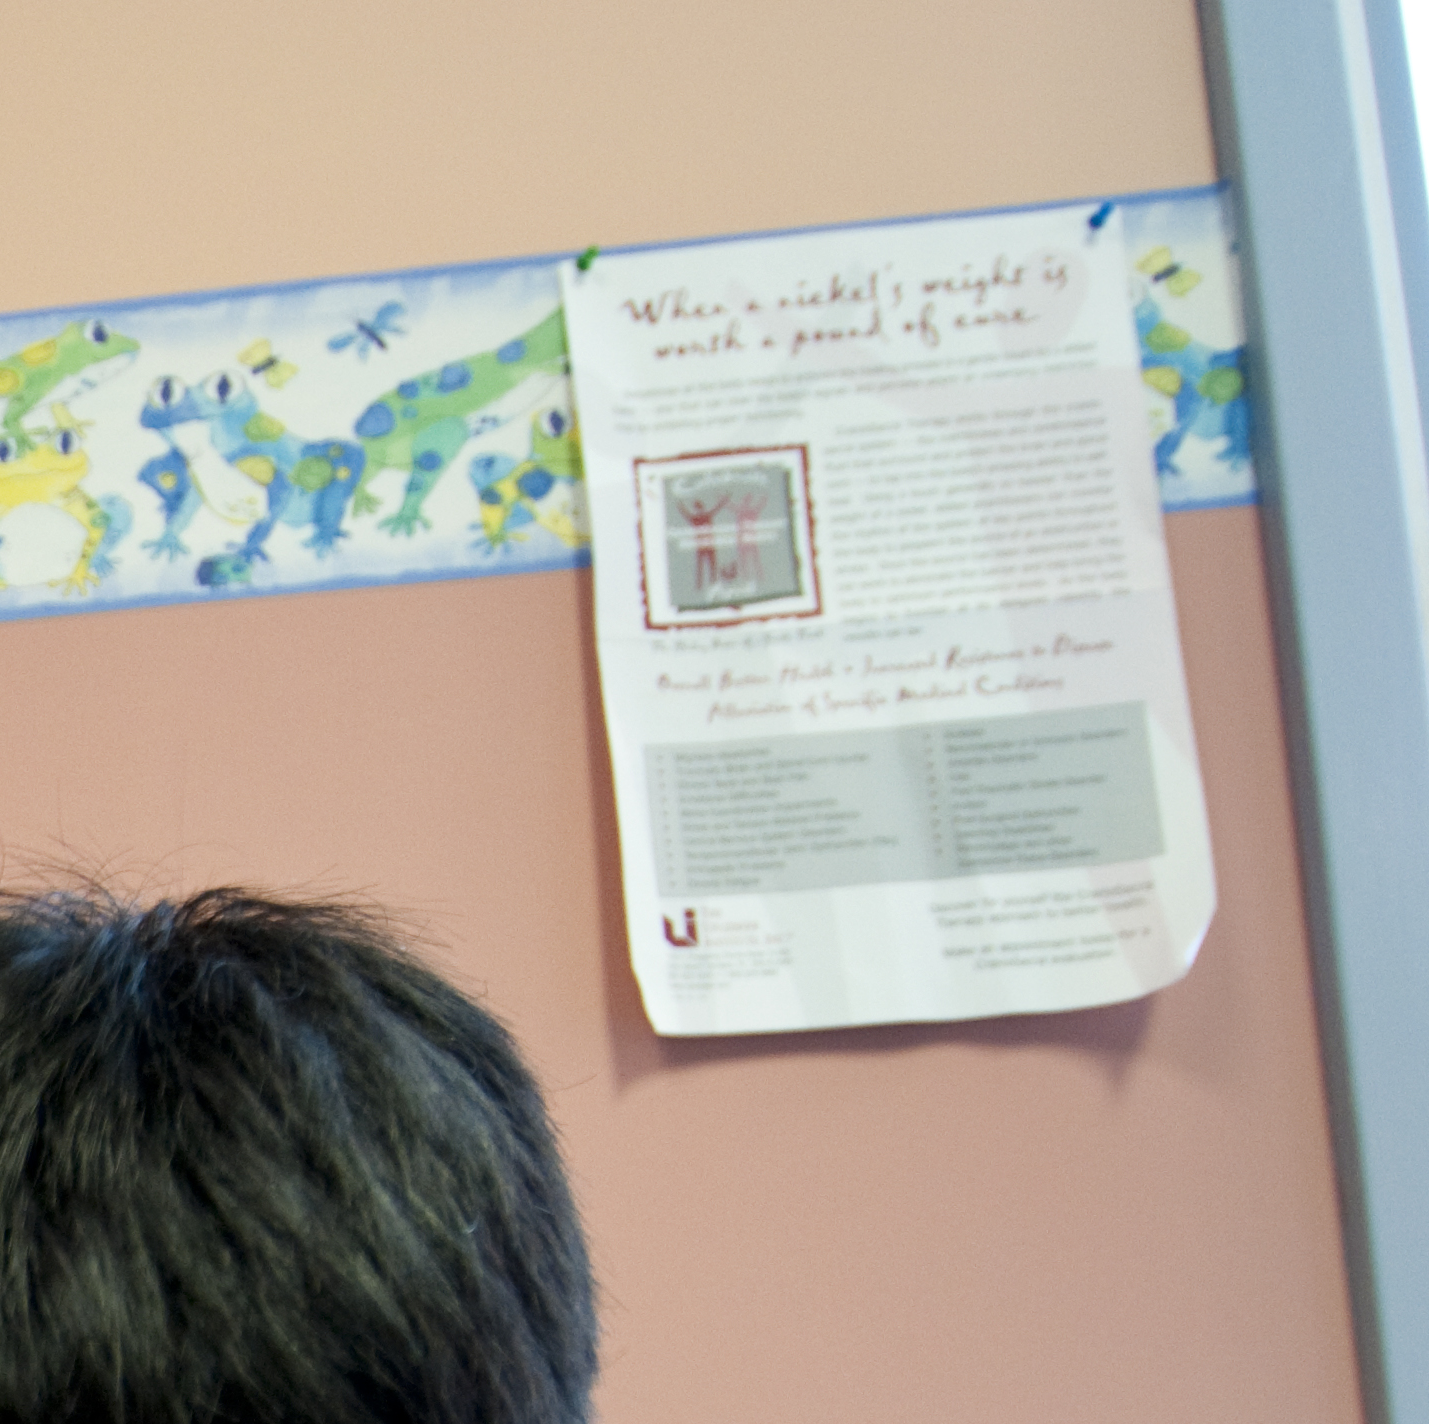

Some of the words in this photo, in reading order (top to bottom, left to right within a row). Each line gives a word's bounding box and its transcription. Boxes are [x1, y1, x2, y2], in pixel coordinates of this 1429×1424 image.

[622, 286, 728, 325] When
[745, 299, 763, 313] a
[779, 262, 903, 308] nickel's
[923, 255, 1024, 306] weight
[1043, 256, 1069, 295] is
[654, 318, 745, 360] worth
[790, 307, 887, 360] pound
[902, 301, 940, 349] of
